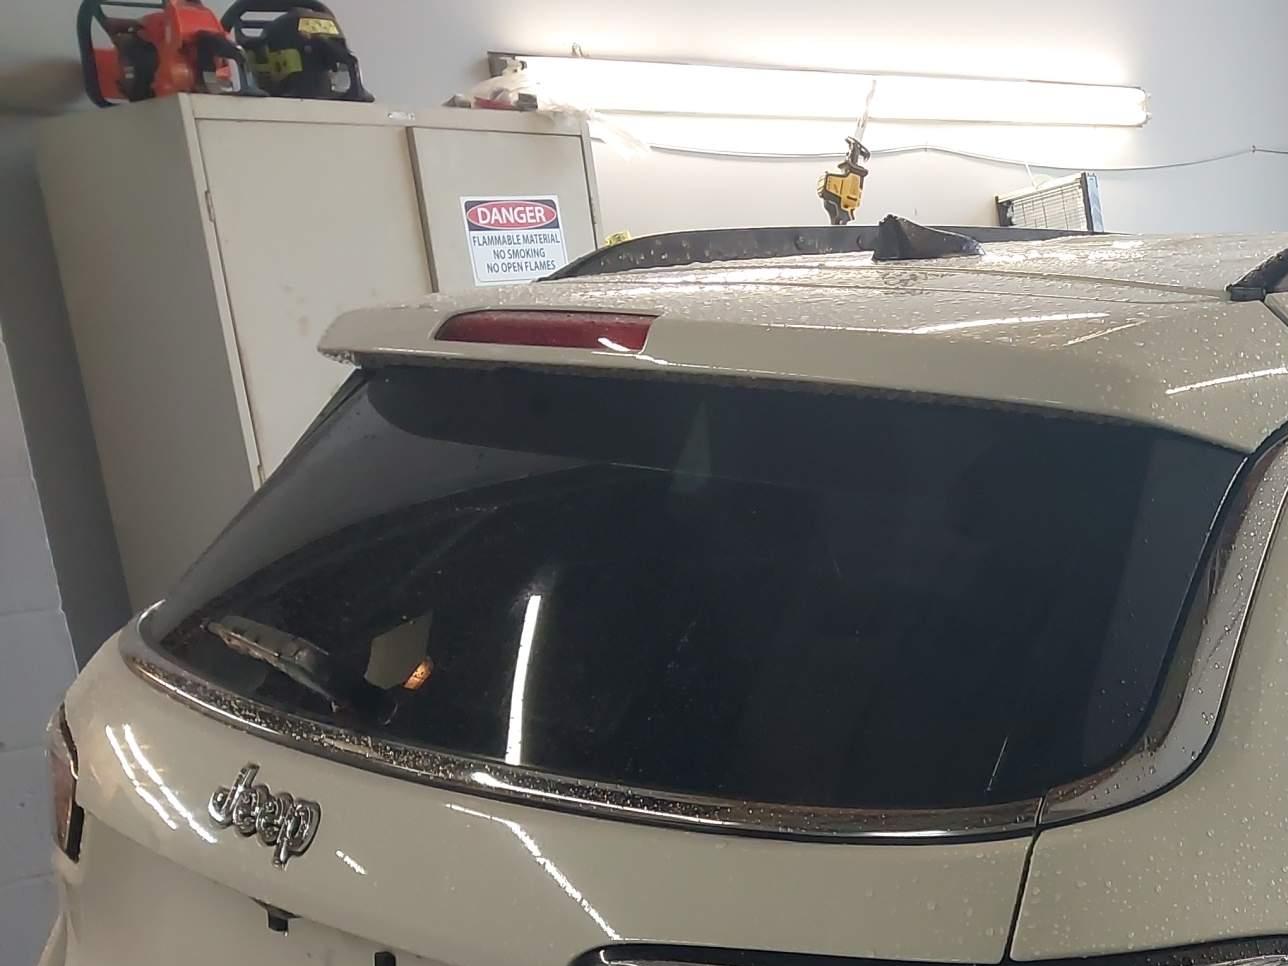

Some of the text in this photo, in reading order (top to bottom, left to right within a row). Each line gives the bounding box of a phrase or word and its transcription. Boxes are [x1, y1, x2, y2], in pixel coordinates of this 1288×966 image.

[476, 206, 547, 225] DANGER
[472, 232, 561, 247] FLAMMABLE MATERIAL
[493, 247, 546, 260] NO SMOKING
[486, 259, 556, 274] NO OPEN FLAMES
